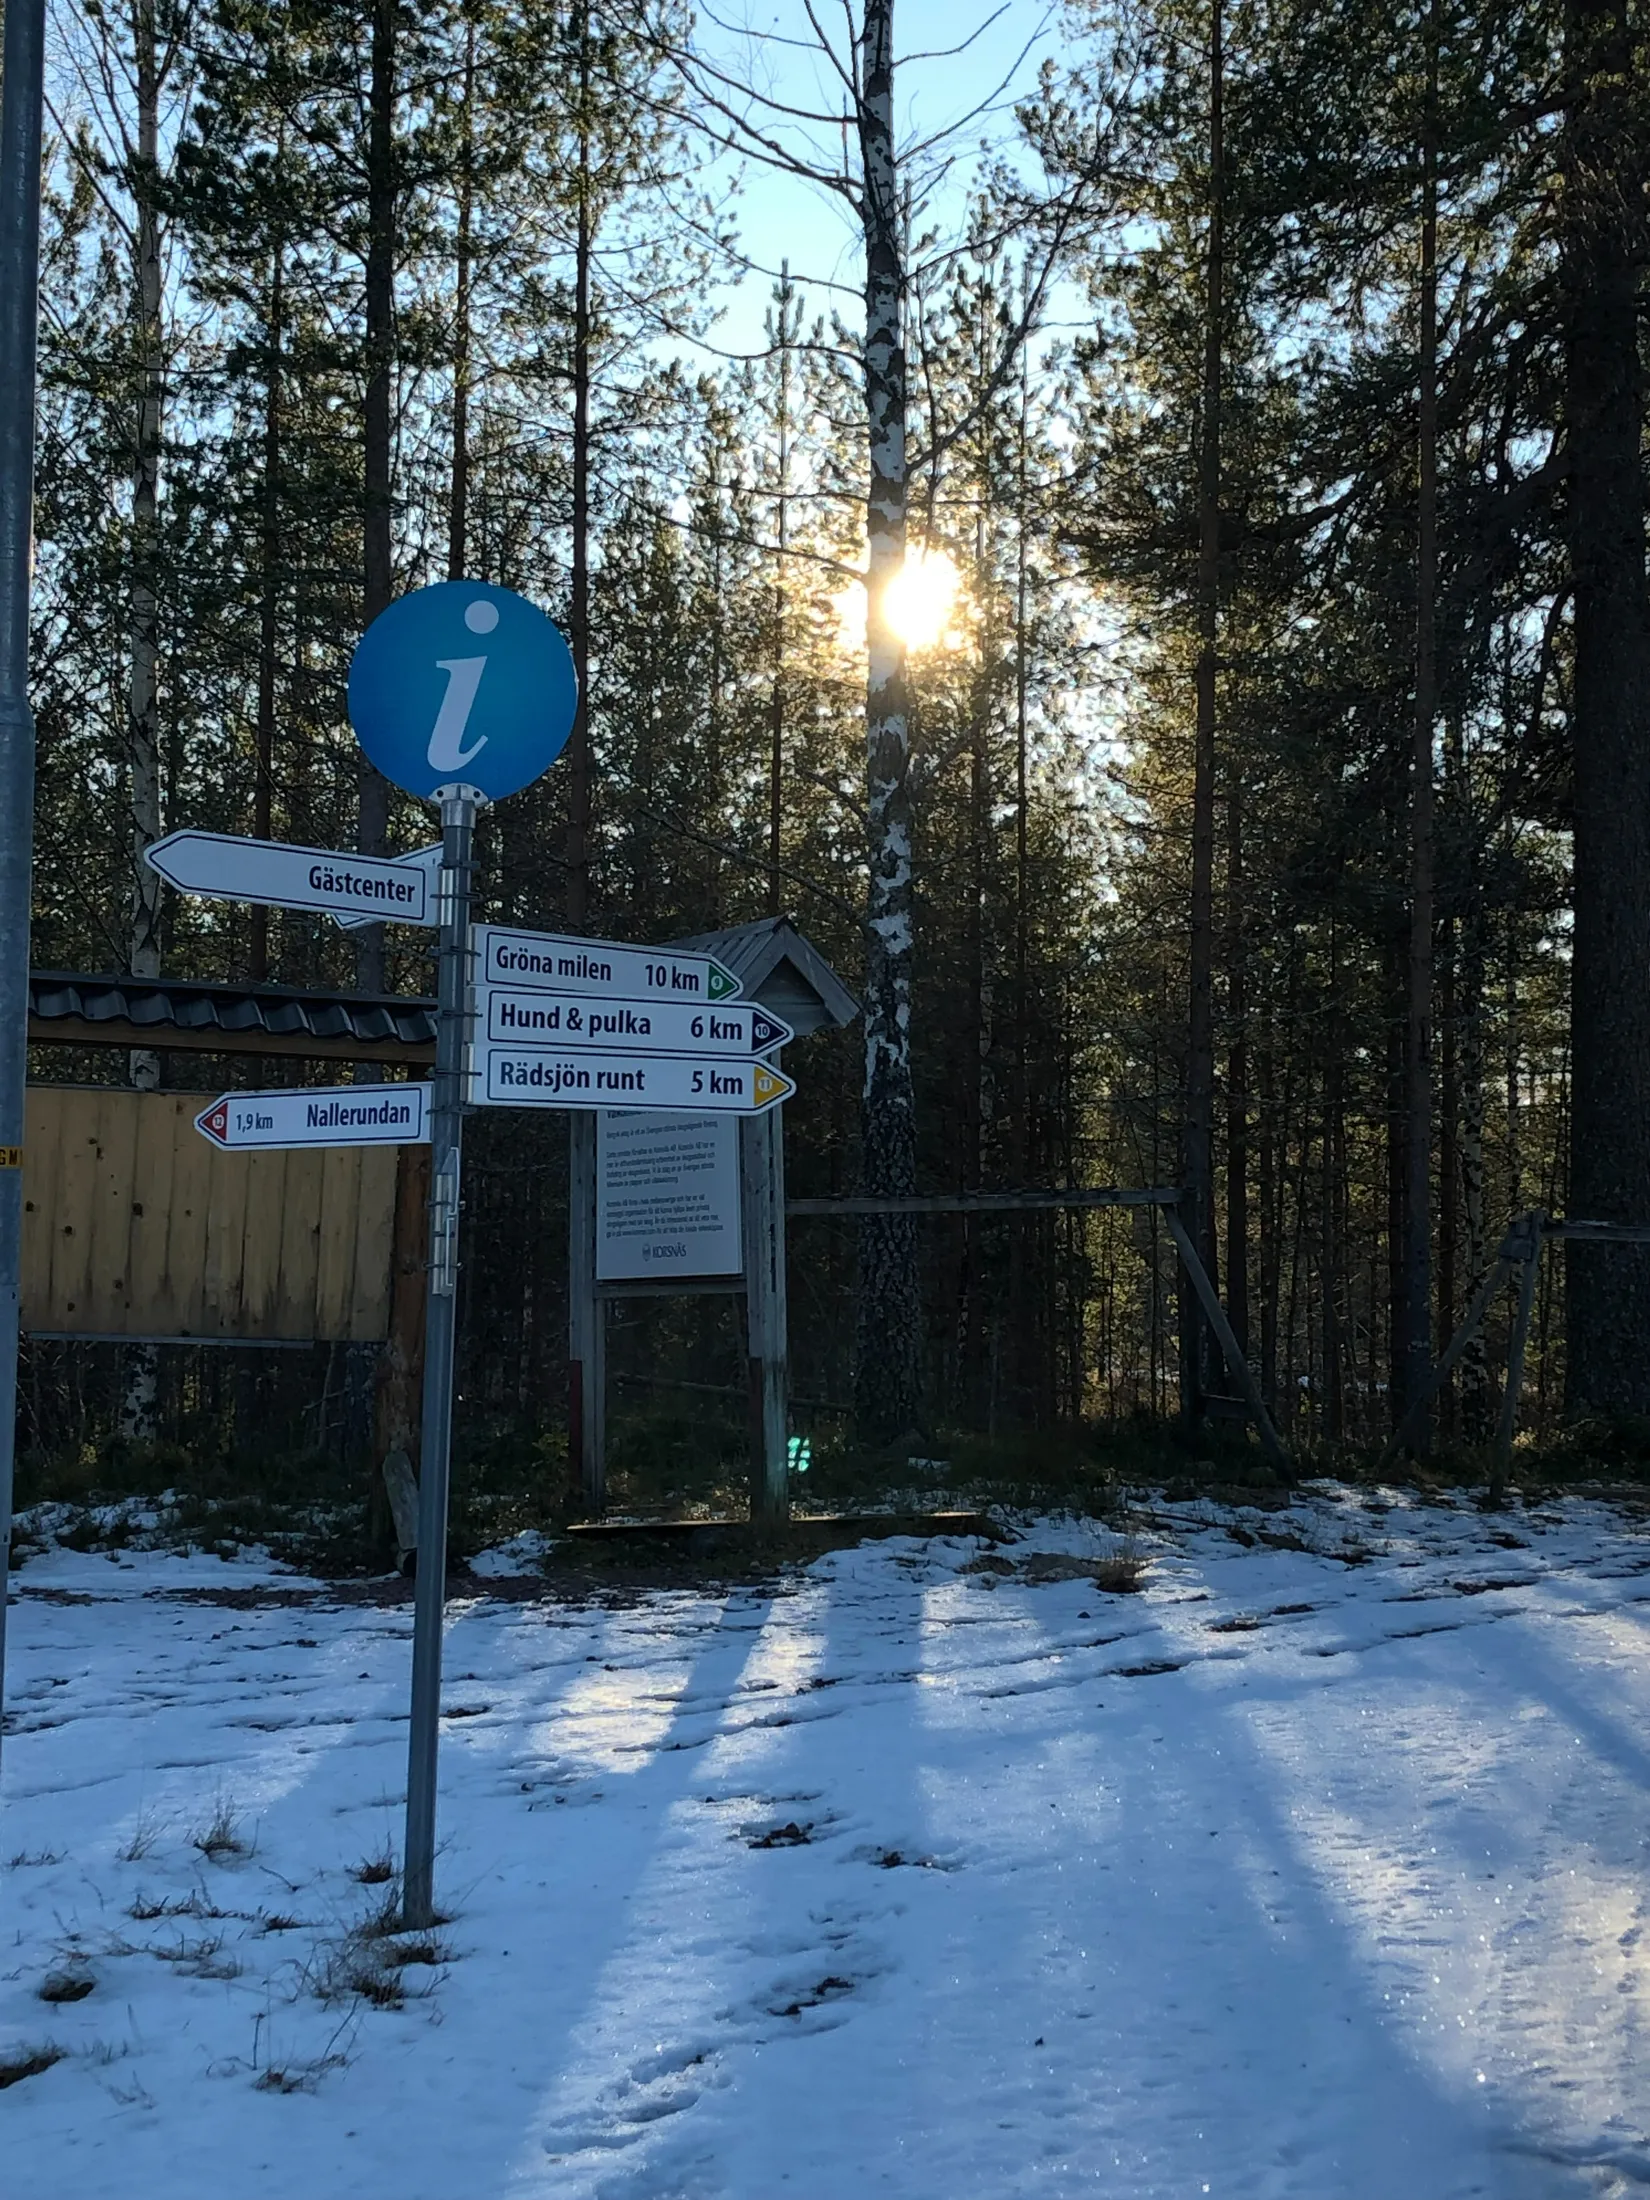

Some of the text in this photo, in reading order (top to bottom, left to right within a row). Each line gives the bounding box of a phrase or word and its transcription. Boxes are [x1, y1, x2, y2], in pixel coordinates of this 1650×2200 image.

[427, 600, 500, 772] i
[309, 866, 416, 903] Gästcenter
[496, 945, 552, 974] Gröna
[558, 956, 612, 981] milen
[645, 964, 667, 987] 10
[671, 966, 700, 991] km
[500, 1003, 768, 1040] Hund & pulka 6 km 10
[500, 1061, 590, 1093] Rädsjön
[596, 1070, 645, 1091] runt
[690, 1071, 703, 1093] 5
[709, 1070, 744, 1094] km
[236, 1113, 253, 1133] 1,9
[255, 1112, 273, 1129] km
[306, 1101, 410, 1129] Nallerundan
